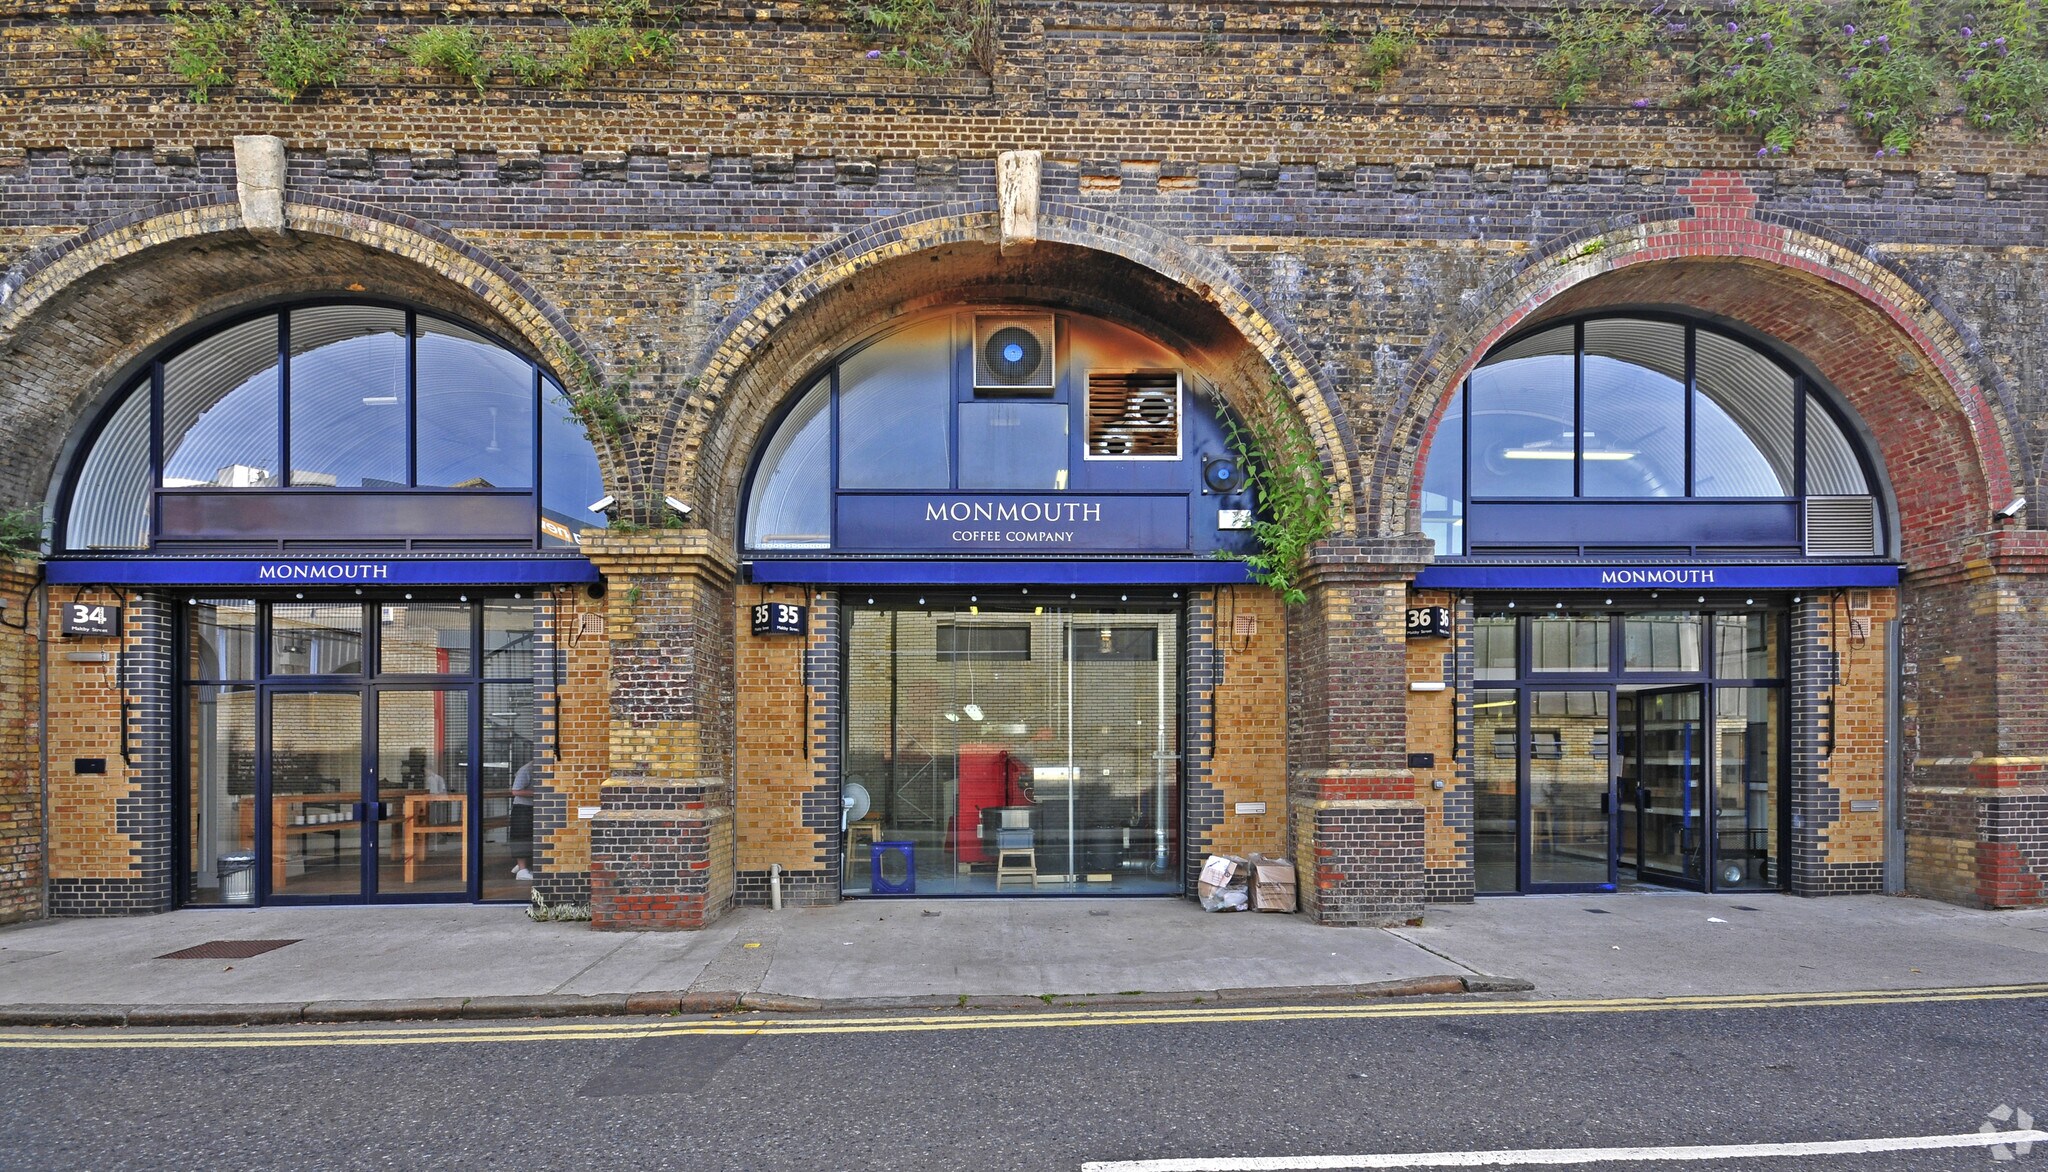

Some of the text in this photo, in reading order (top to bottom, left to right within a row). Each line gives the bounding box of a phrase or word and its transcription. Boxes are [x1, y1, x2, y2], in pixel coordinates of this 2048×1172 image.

[925, 502, 1101, 522] MONMOUTH
[952, 530, 1074, 542] COFFEE COMPANY
[259, 564, 387, 578] MONMOUTH
[1602, 570, 1715, 583] MONMOUTH
[73, 604, 107, 624] 34
[755, 604, 769, 624] 35
[778, 604, 799, 624] 35
[1408, 608, 1431, 627] 36
[1439, 608, 1449, 627] 36
